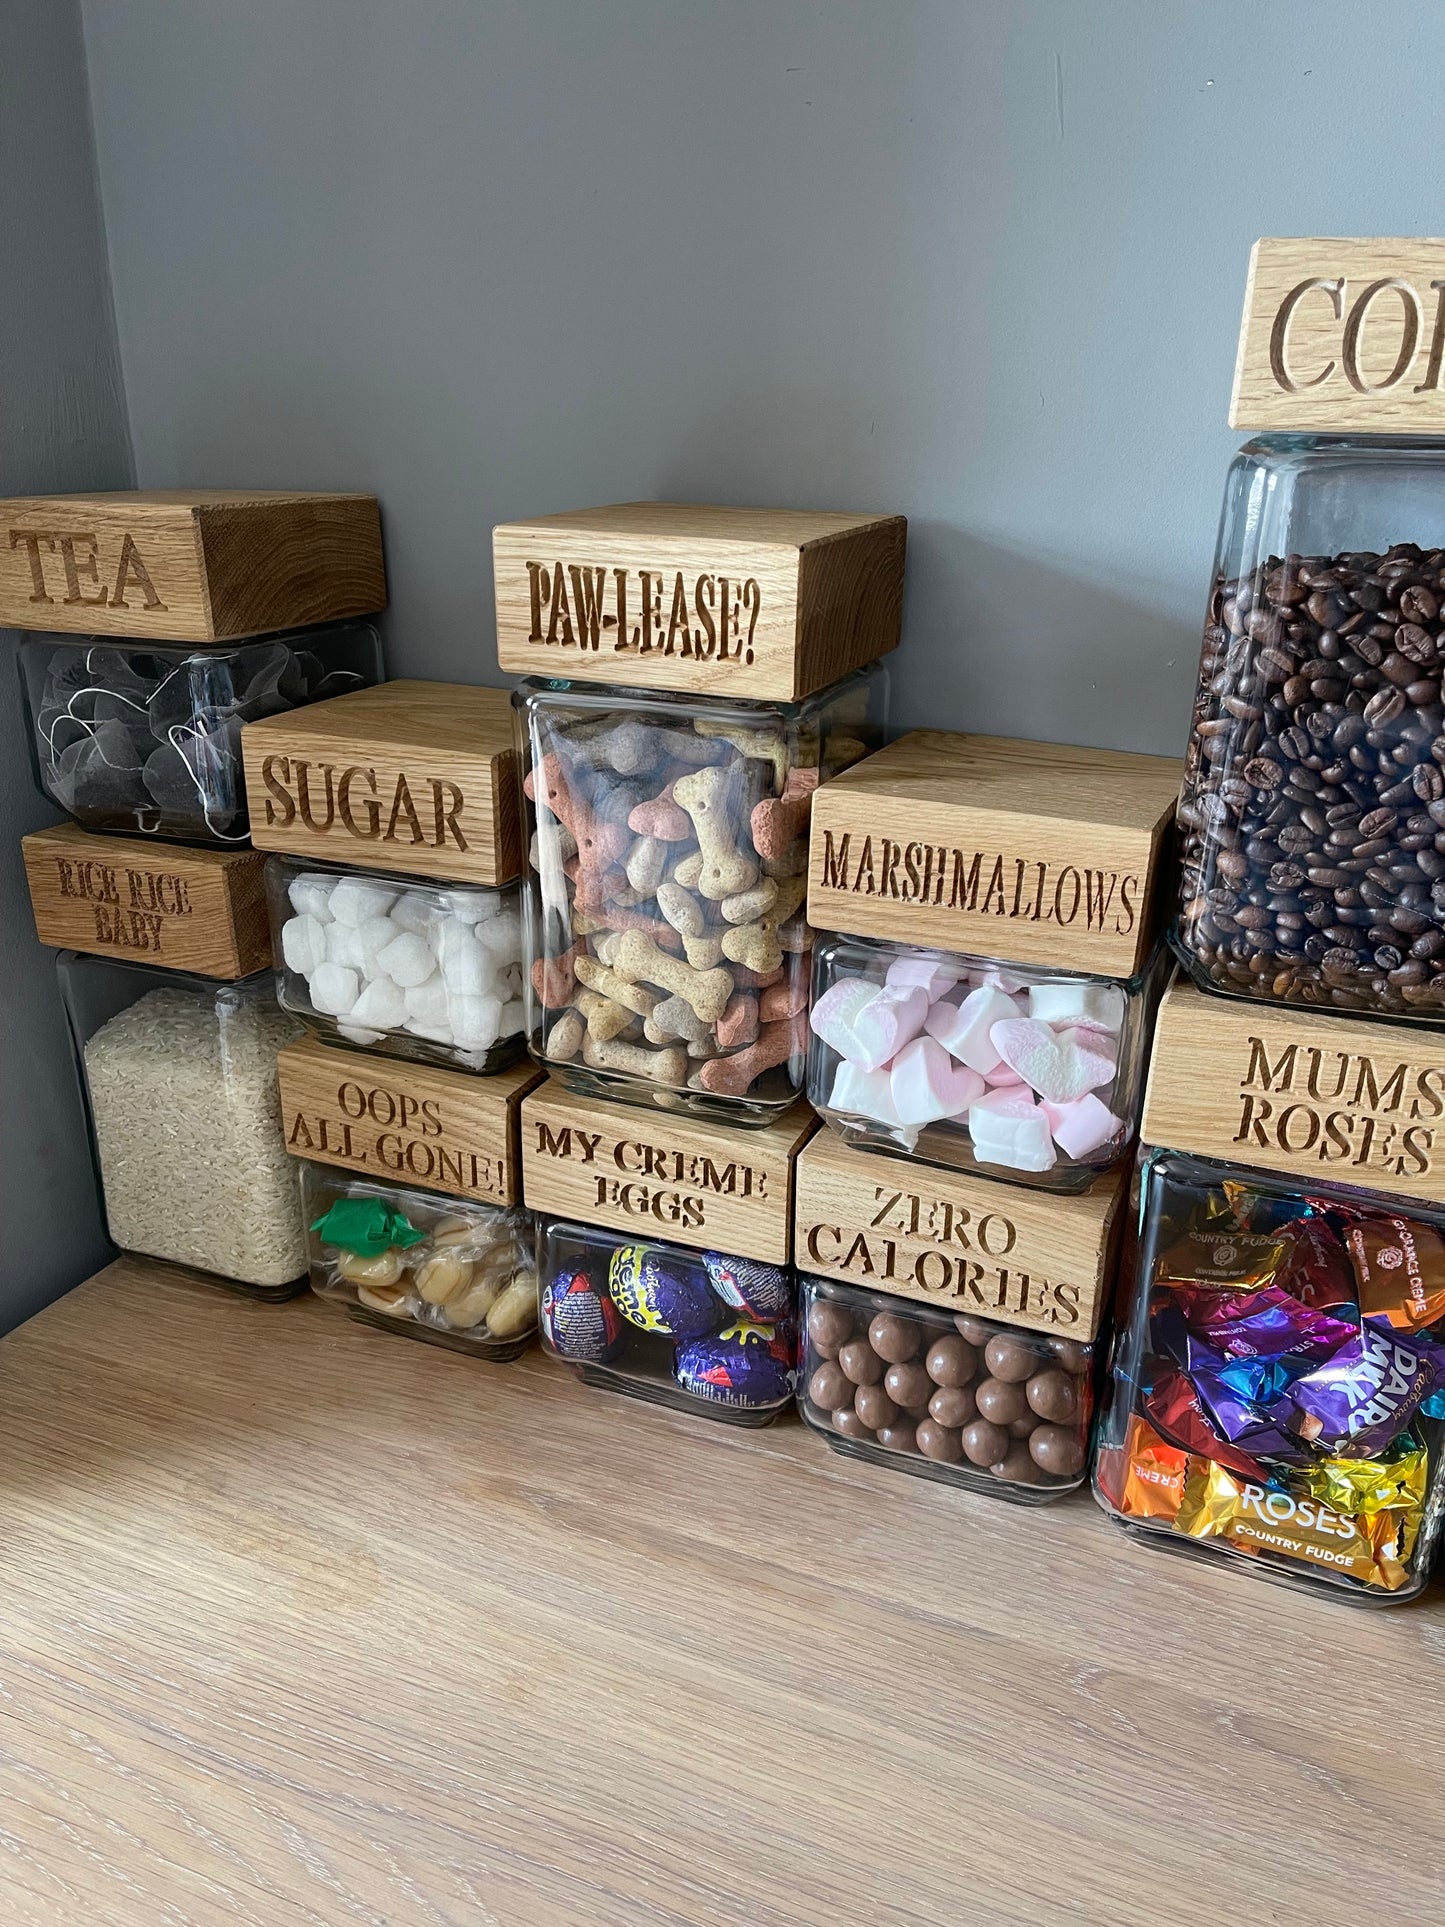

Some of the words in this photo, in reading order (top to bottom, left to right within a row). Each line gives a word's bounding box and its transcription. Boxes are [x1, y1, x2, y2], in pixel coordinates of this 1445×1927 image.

[8, 529, 168, 612] TEA
[525, 560, 761, 665] PAW-LEASE?
[261, 755, 471, 853] SUGAR
[56, 857, 120, 904] RICE
[125, 868, 193, 917] RICE
[820, 829, 1138, 936] MARSHMALLOWS
[93, 902, 164, 951] BABY
[337, 1081, 443, 1138] OOPS
[1239, 1036, 1445, 1121] MUMS
[287, 1112, 367, 1163] ALL
[375, 1133, 505, 1197] GONE!
[535, 1121, 603, 1164] MY
[613, 1140, 769, 1199] CREME
[1232, 1093, 1436, 1178] ROSES
[593, 1175, 706, 1230] EGGS
[870, 1187, 1017, 1257] ZERO
[1188, 1231, 1237, 1245] COUNTRY
[806, 1223, 1081, 1326] CALORIES
[1392, 1358, 1436, 1422] Cadbury
[1135, 1466, 1179, 1489] CREME
[1240, 1483, 1357, 1539] ROSES
[1235, 1524, 1303, 1552] COUNTRY
[1304, 1545, 1355, 1567] FUDGE
